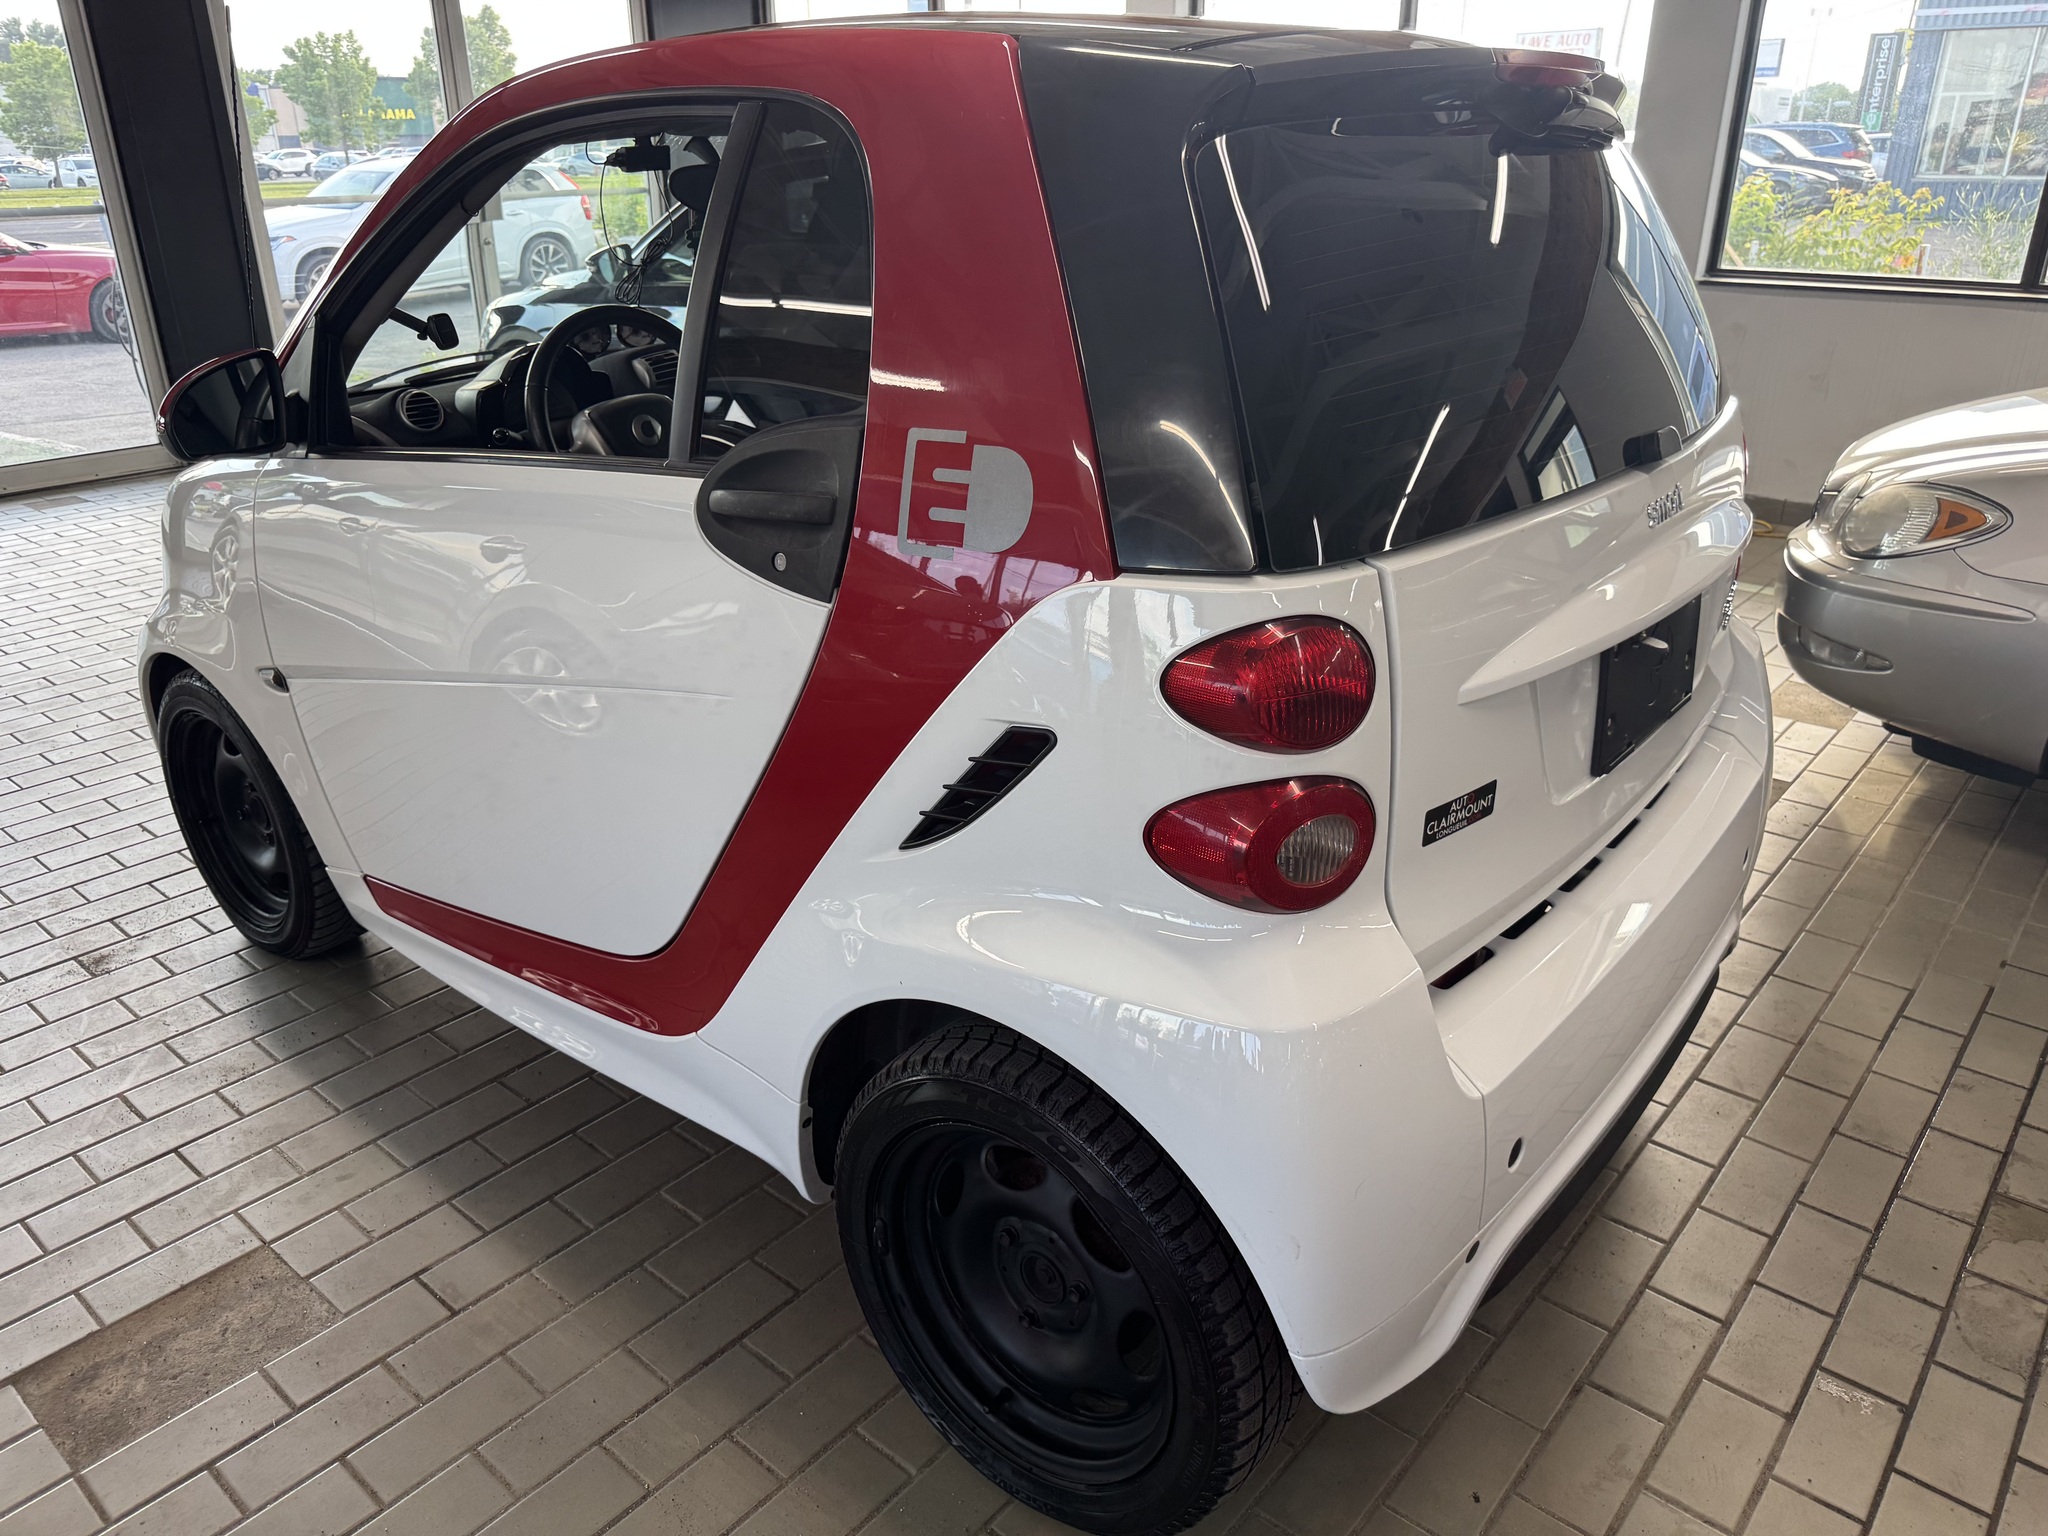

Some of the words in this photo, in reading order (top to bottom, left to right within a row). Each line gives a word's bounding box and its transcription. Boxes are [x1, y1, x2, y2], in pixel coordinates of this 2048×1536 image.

[1556, 33, 1592, 47] AUTO
[1866, 37, 1891, 128] enterprise
[1426, 794, 1493, 835] CLAIRMOUNT
[1449, 792, 1475, 814] AUTO
[960, 1087, 1080, 1164] TOYO
